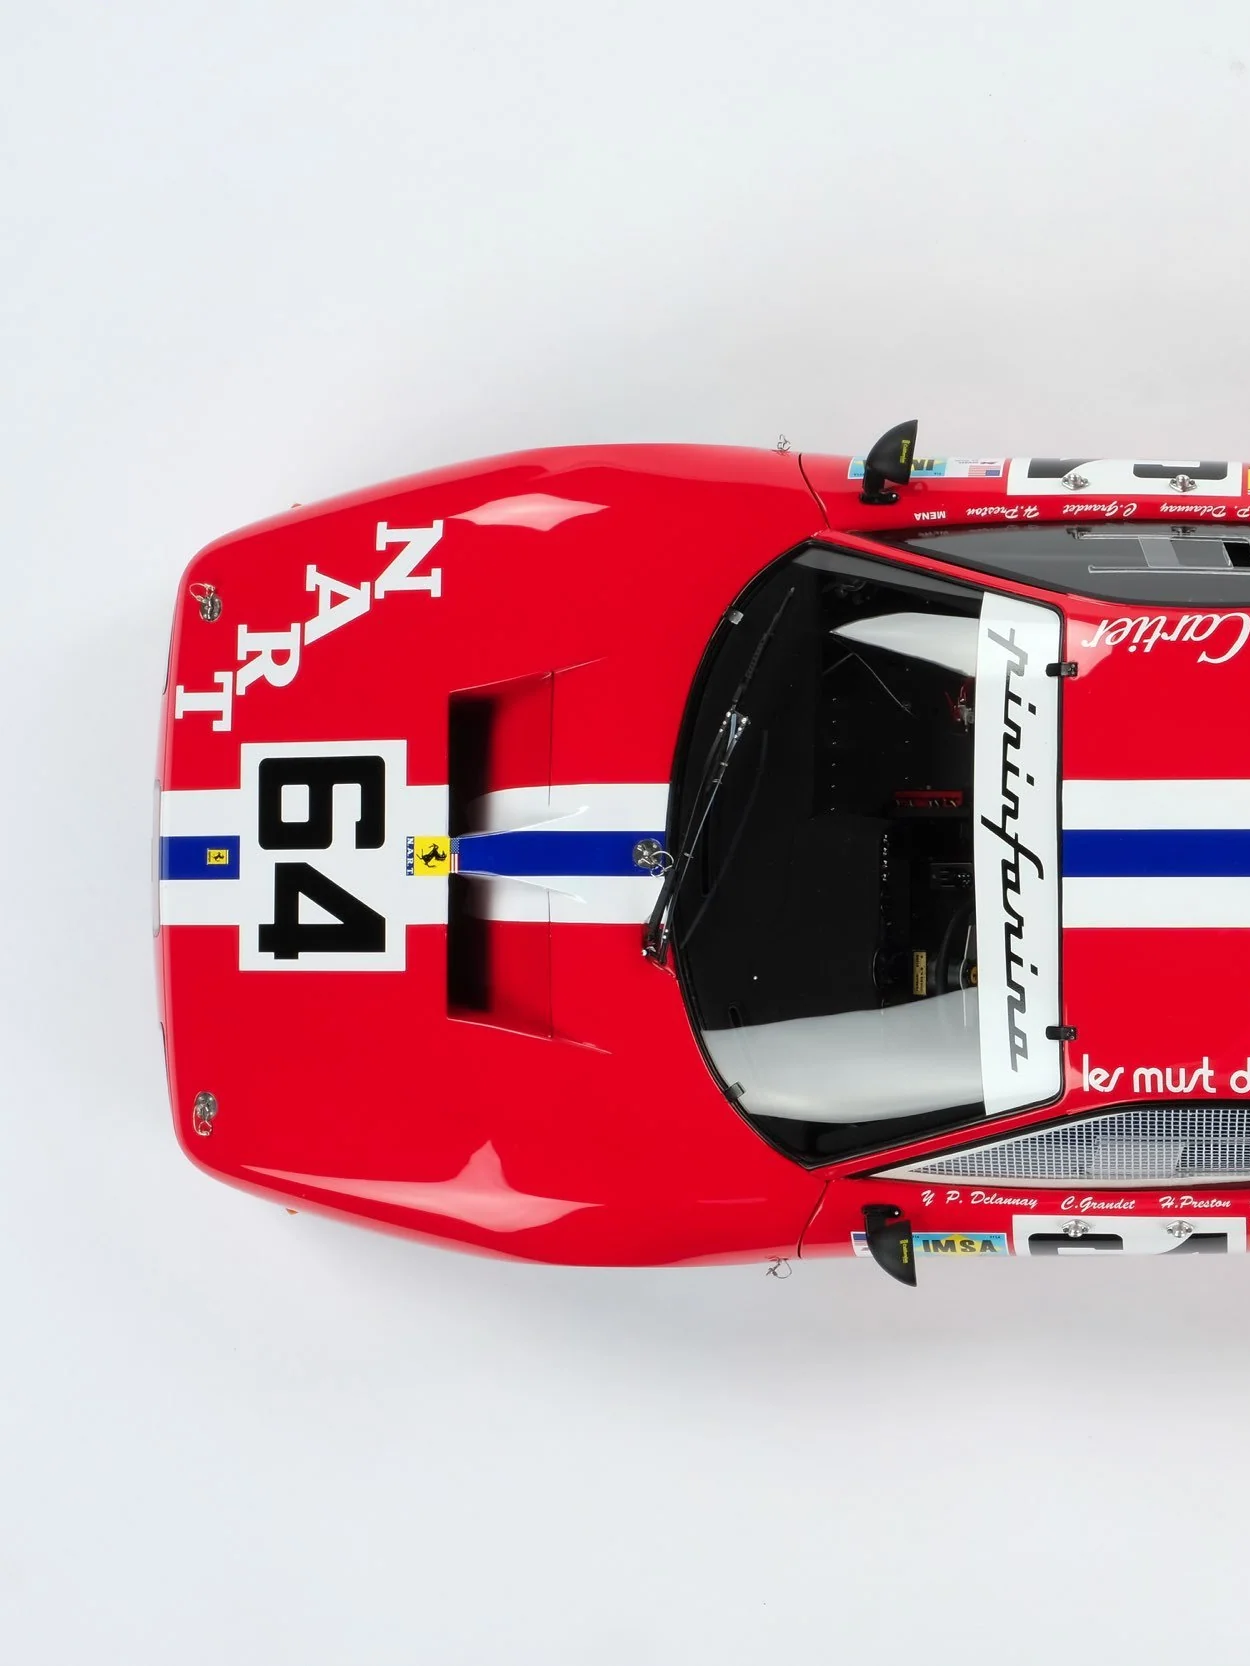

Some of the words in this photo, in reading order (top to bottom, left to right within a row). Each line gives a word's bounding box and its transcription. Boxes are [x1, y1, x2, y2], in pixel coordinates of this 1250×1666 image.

[913, 510, 946, 521] MENA
[1159, 502, 1227, 519] Delannay
[174, 519, 444, 732] NART
[258, 755, 386, 960] 64
[980, 627, 1044, 1073] pininfarina
[1082, 1055, 1125, 1093] les
[1132, 1056, 1216, 1094] must
[945, 1190, 965, 1206] P.
[970, 1190, 1038, 1210] Delannay
[922, 1239, 998, 1254] IMSA
